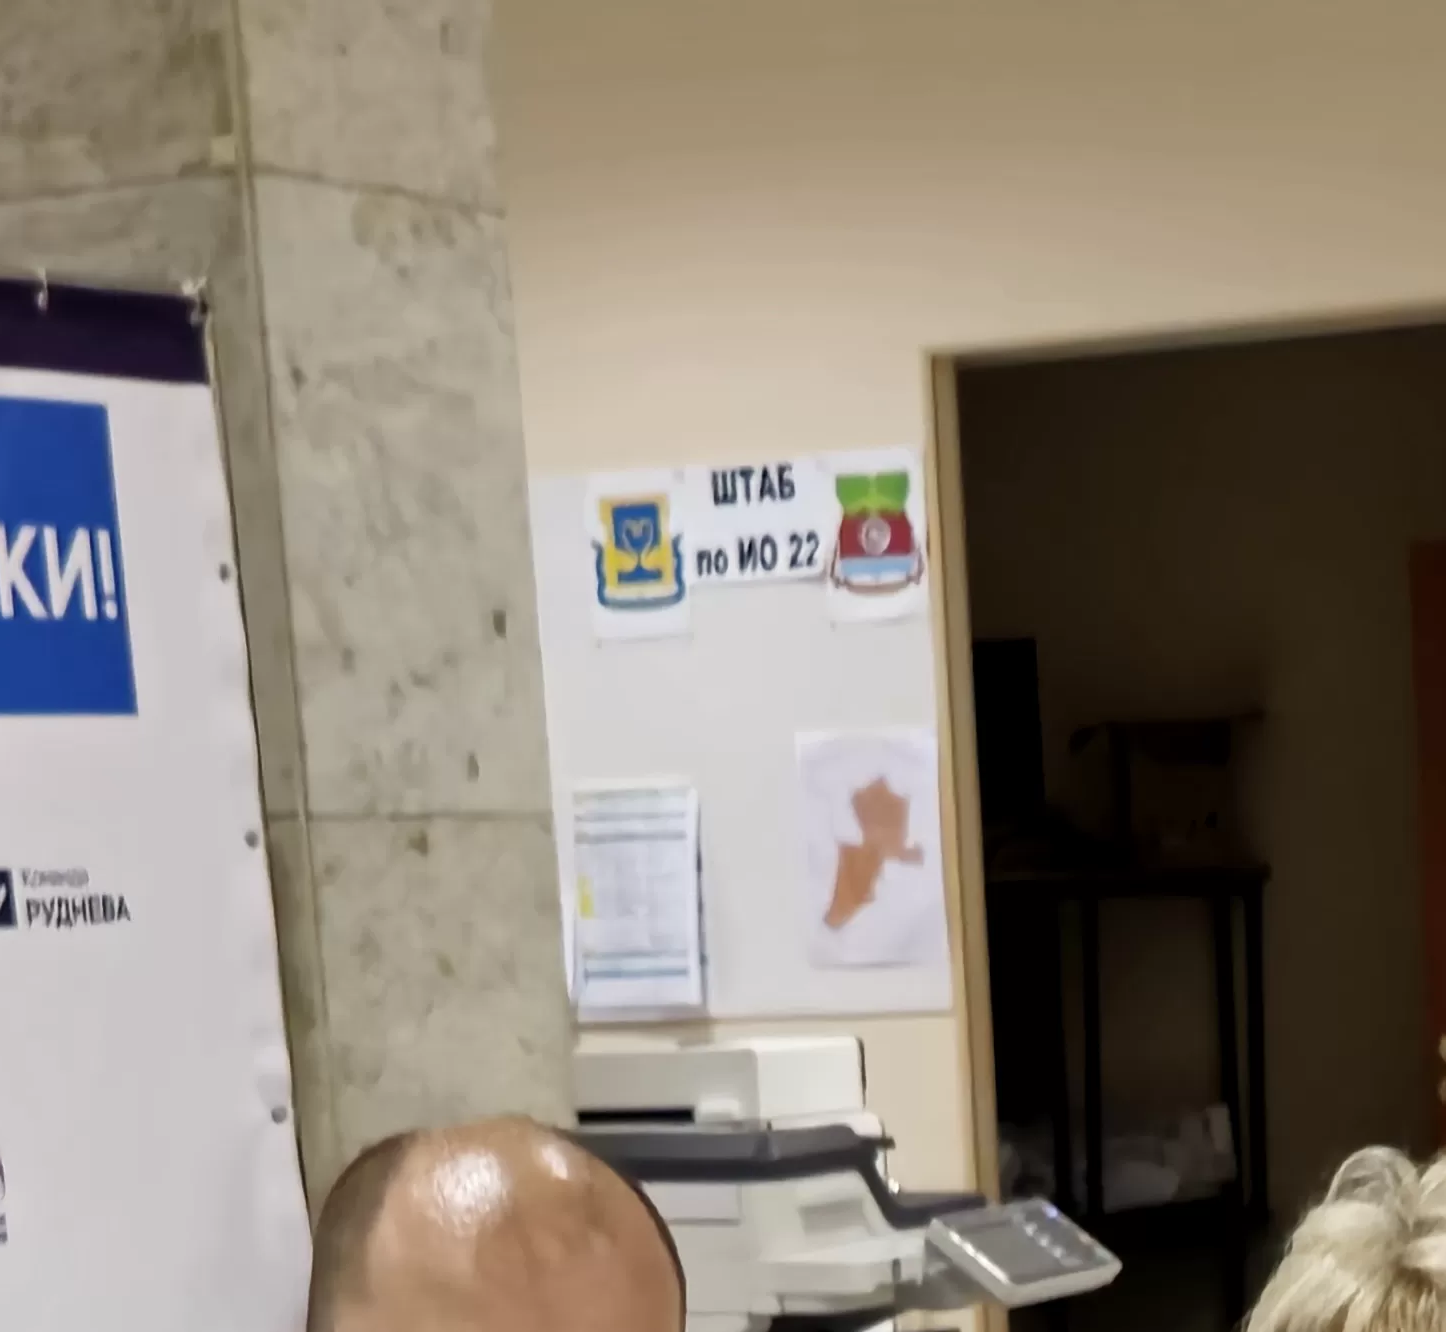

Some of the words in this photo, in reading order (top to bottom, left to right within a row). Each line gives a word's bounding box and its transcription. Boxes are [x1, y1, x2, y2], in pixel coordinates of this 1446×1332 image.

[711, 463, 796, 506] ШТАБ
[696, 545, 728, 577] по
[738, 536, 778, 573] ИО
[789, 530, 820, 569] 22
[25, 896, 131, 929] РУДНЕВА
